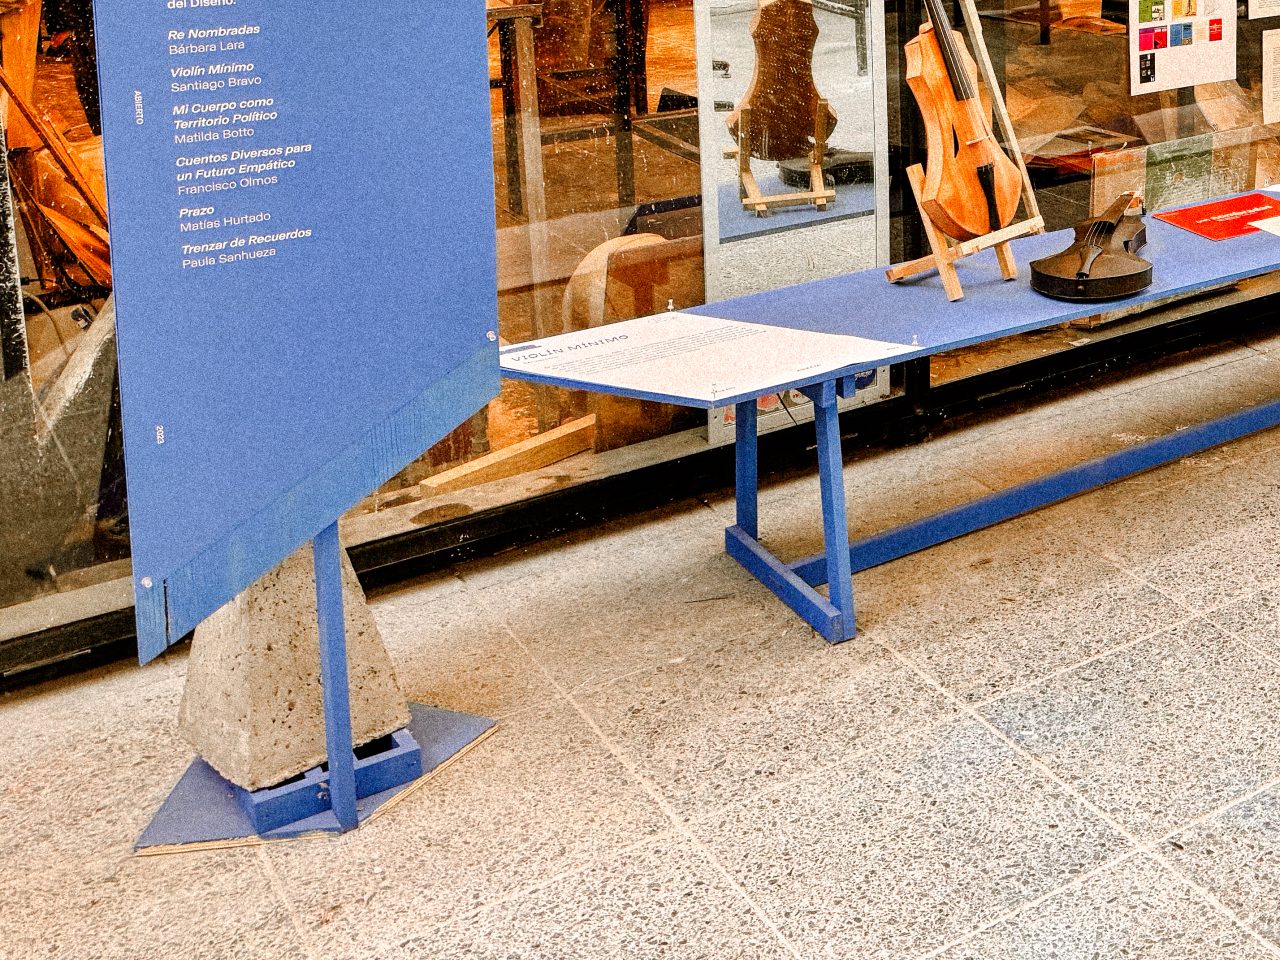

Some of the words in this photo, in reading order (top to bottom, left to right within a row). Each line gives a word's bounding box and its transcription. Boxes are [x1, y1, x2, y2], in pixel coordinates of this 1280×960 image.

[168, 30, 185, 40] Re
[188, 25, 260, 39] Nombradas
[169, 44, 216, 55] Bárbara
[220, 41, 245, 51] Lara
[170, 65, 205, 78] Violín
[208, 62, 254, 74] Mínimo
[171, 80, 225, 92] Santiago
[228, 77, 261, 87] Bravo
[134, 90, 144, 125] ABIERTO
[172, 104, 189, 115] Mi
[191, 102, 237, 113] Cuerpo
[239, 98, 274, 108] como
[174, 115, 230, 129] Territorio
[232, 111, 278, 123] Político
[174, 131, 219, 144] Matilda
[222, 128, 254, 139] Botto
[176, 154, 228, 167] Cuentos
[230, 147, 283, 161] Diversos
[285, 144, 312, 156] para
[176, 172, 192, 181] un
[195, 167, 236, 179] Futuro
[238, 159, 295, 173] Empático
[178, 181, 237, 195] Francisco
[240, 176, 278, 187] Olmos
[179, 207, 214, 218] Prazo
[180, 219, 220, 232] Matías
[223, 212, 271, 226] Hurtado
[182, 241, 228, 254] Trenzar
[230, 237, 246, 248] de
[248, 229, 312, 245] Recuerdos
[182, 256, 215, 268] Paula
[219, 248, 276, 263] Sanhueza
